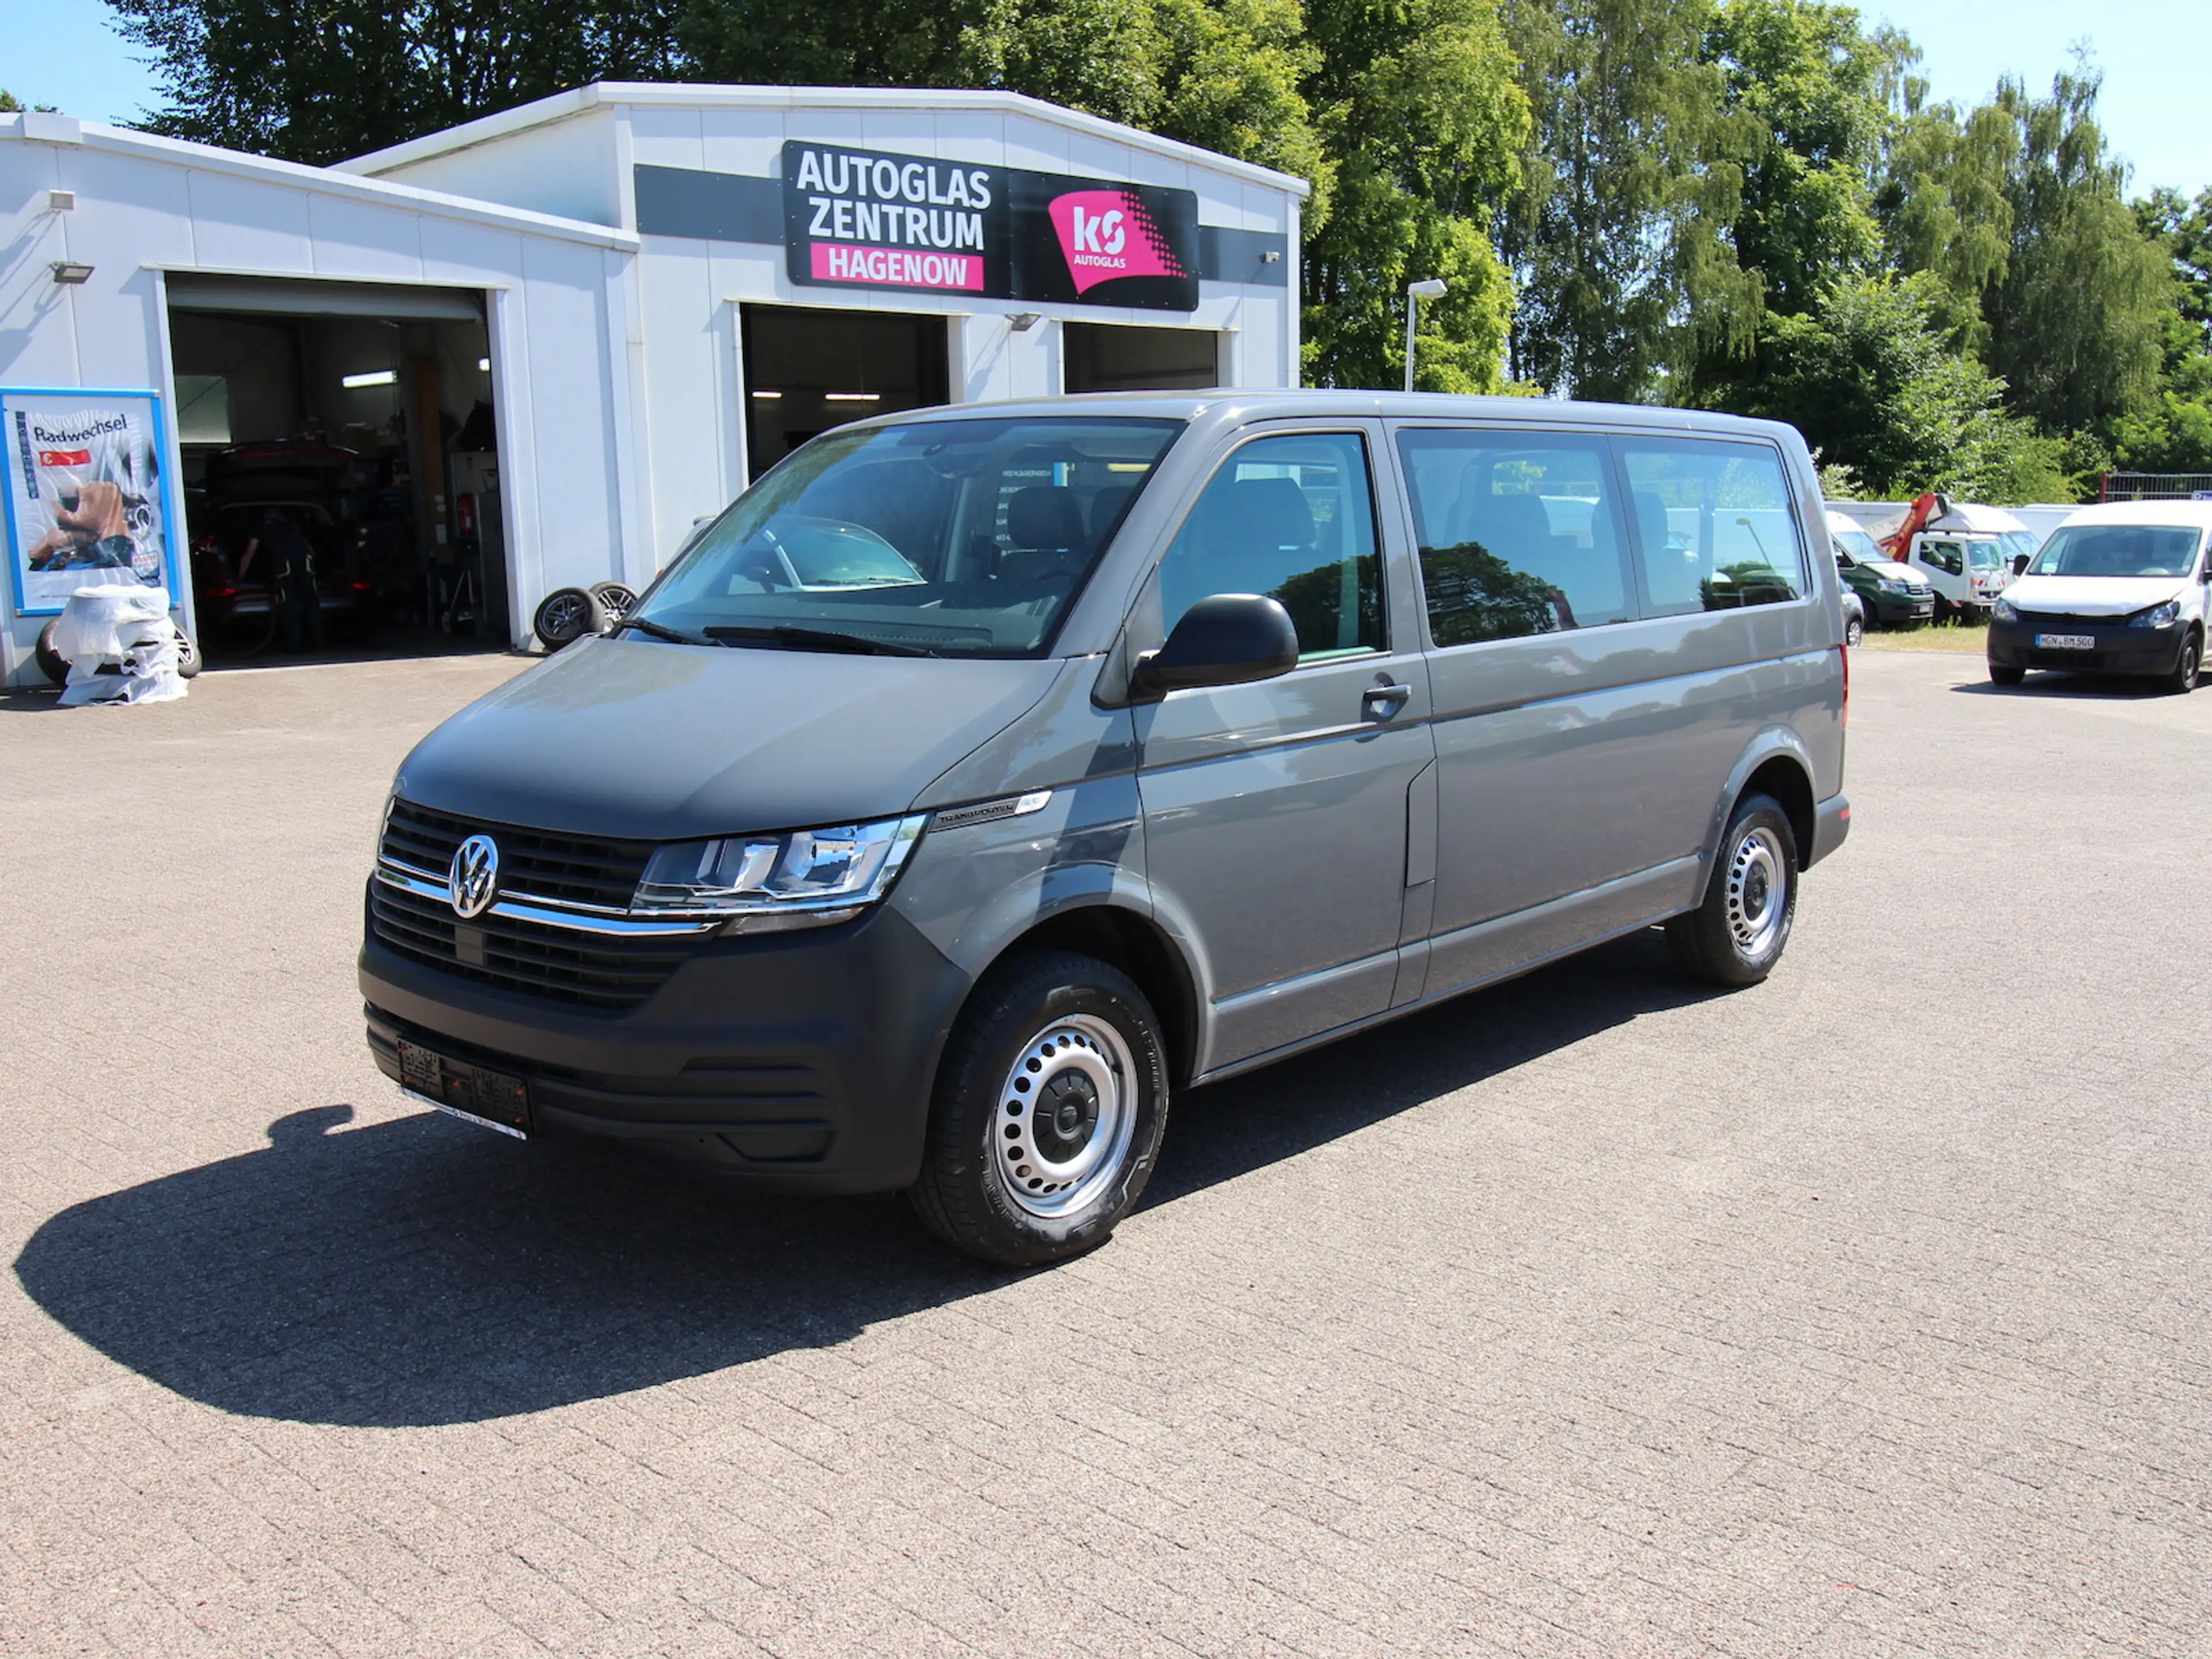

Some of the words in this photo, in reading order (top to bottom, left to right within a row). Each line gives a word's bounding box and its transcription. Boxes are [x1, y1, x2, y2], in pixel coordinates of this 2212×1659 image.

[797, 150, 991, 209] AUTOGLAS
[809, 196, 984, 251] ZENTRUM
[829, 248, 967, 286] HAGENOW
[1074, 255, 1126, 268] AUTOGLAS
[34, 413, 127, 442] Radwechsel
